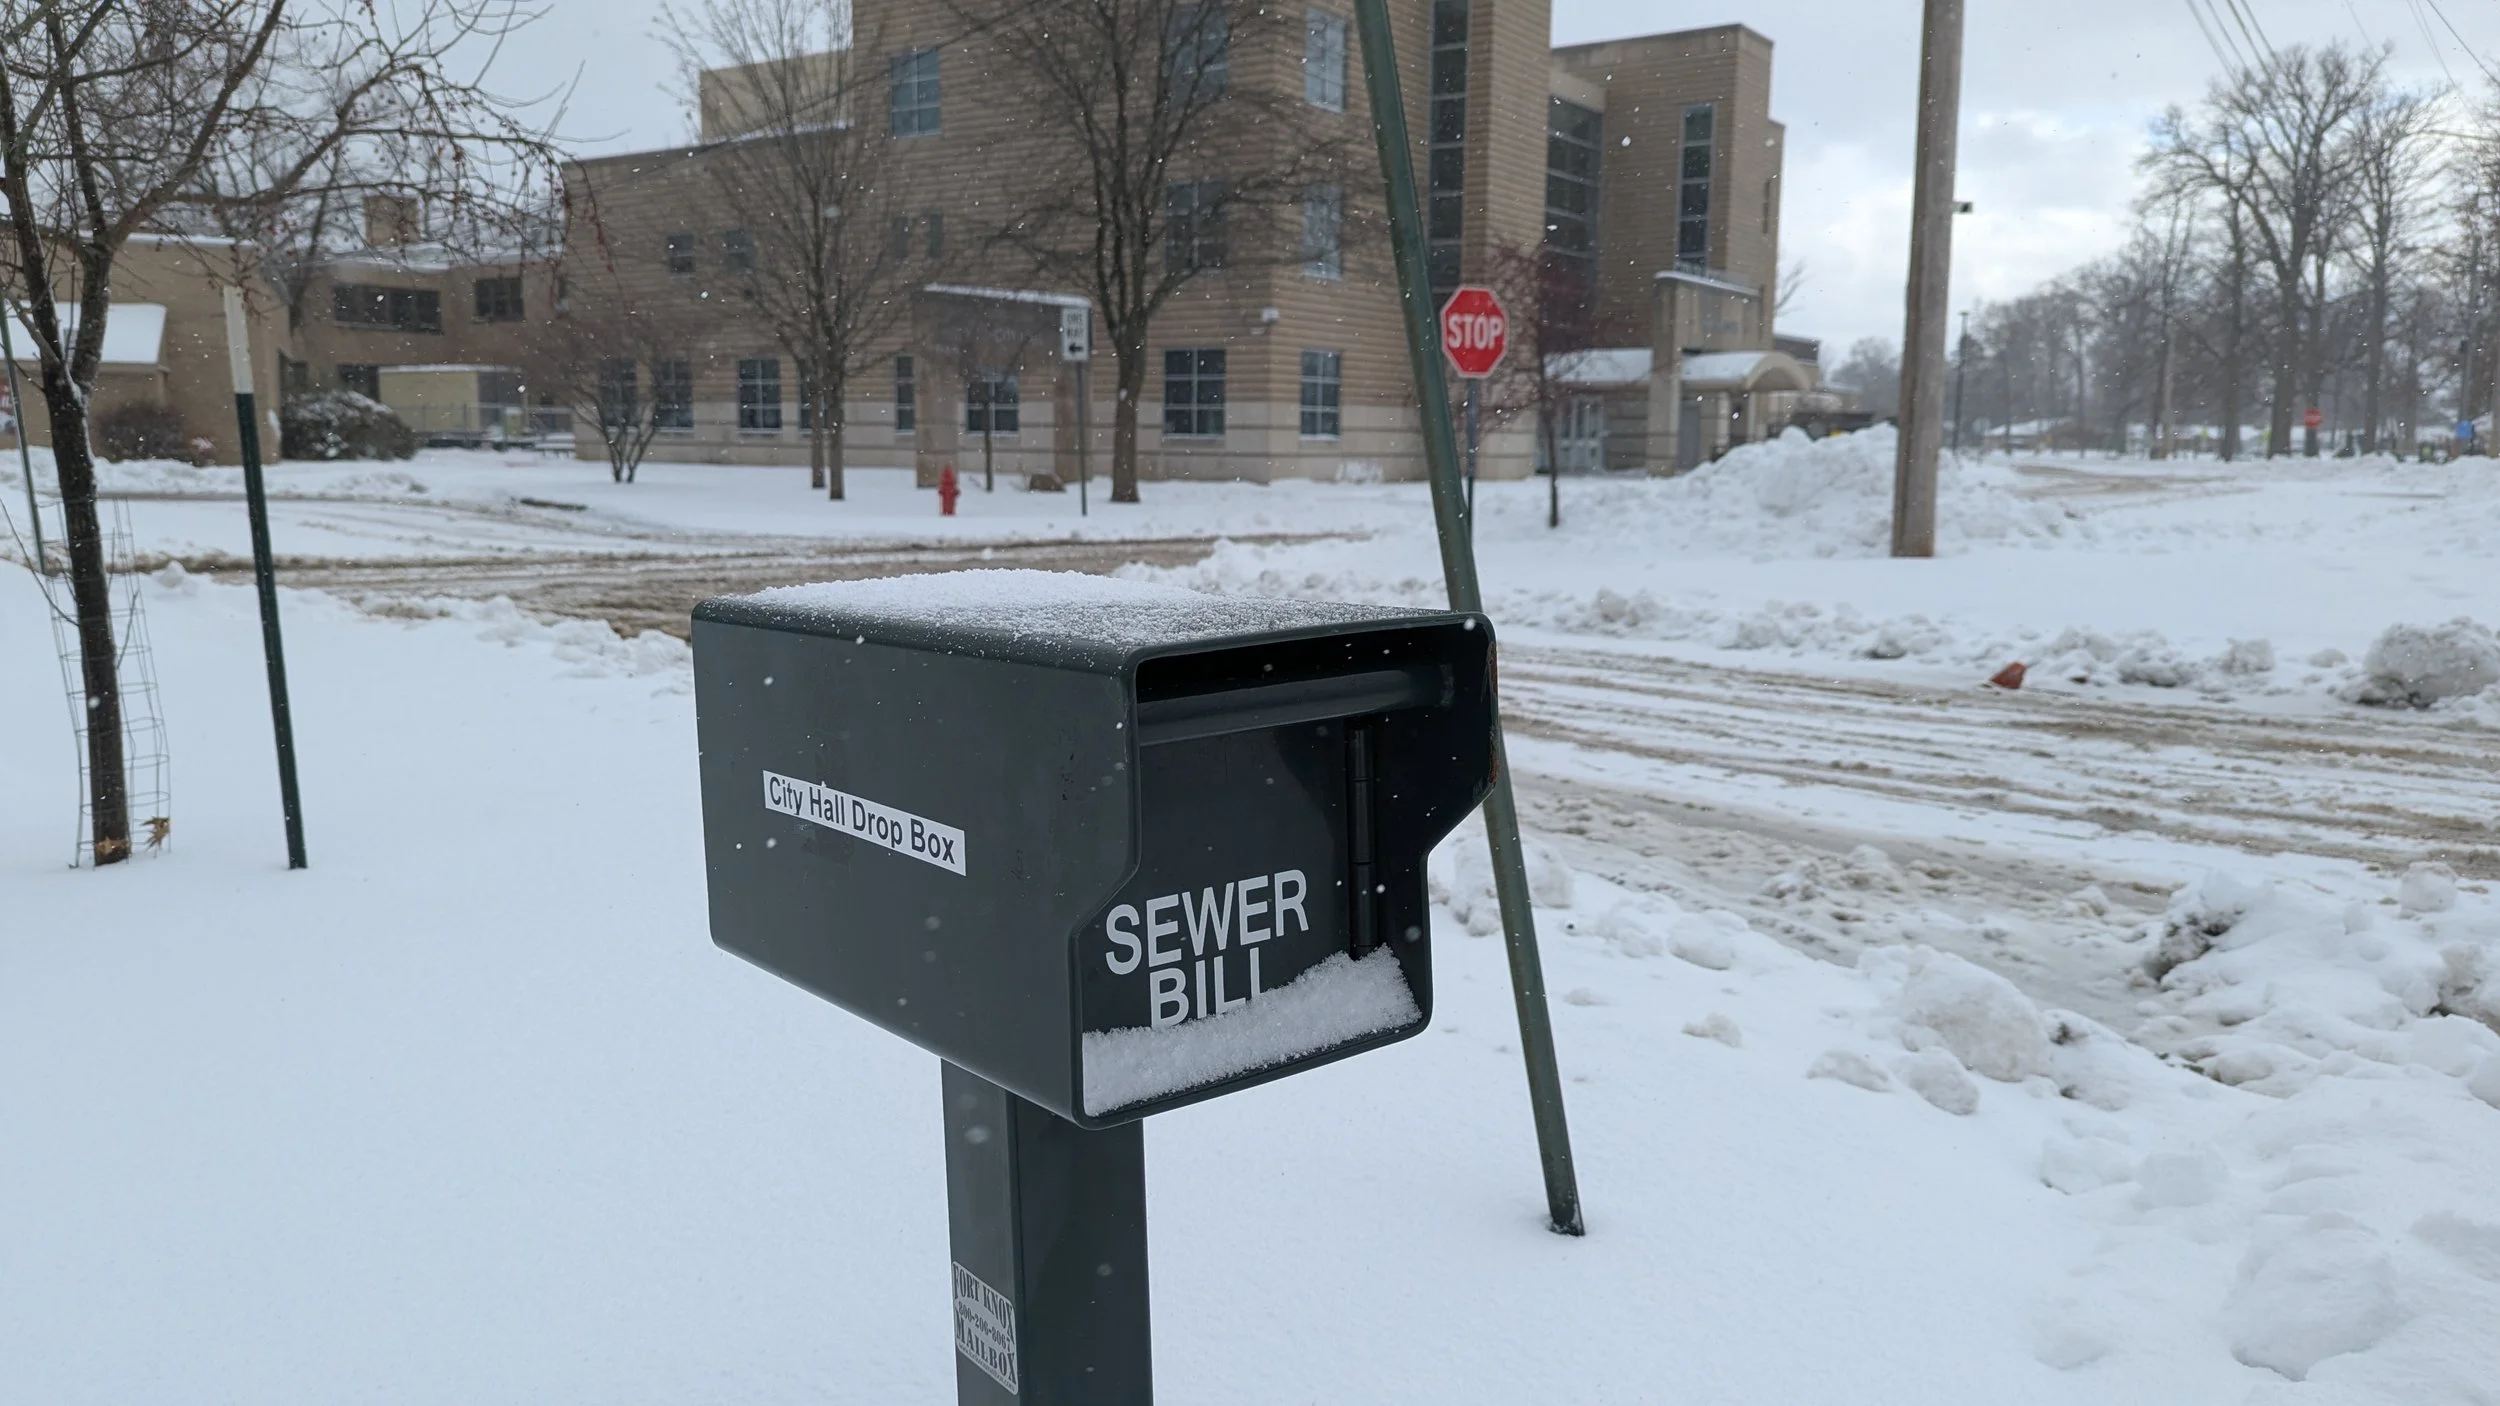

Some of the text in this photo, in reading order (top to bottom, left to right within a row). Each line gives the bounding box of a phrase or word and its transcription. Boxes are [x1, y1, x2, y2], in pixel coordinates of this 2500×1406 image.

[1447, 312, 1504, 350] STOP
[769, 776, 955, 865] City Hall Drop Box
[1105, 869, 1310, 976] SEWER
[1150, 946, 1264, 1030] BILL
[953, 1263, 1015, 1344] FORT KNOX
[954, 1307, 1017, 1385] MAILBOX
